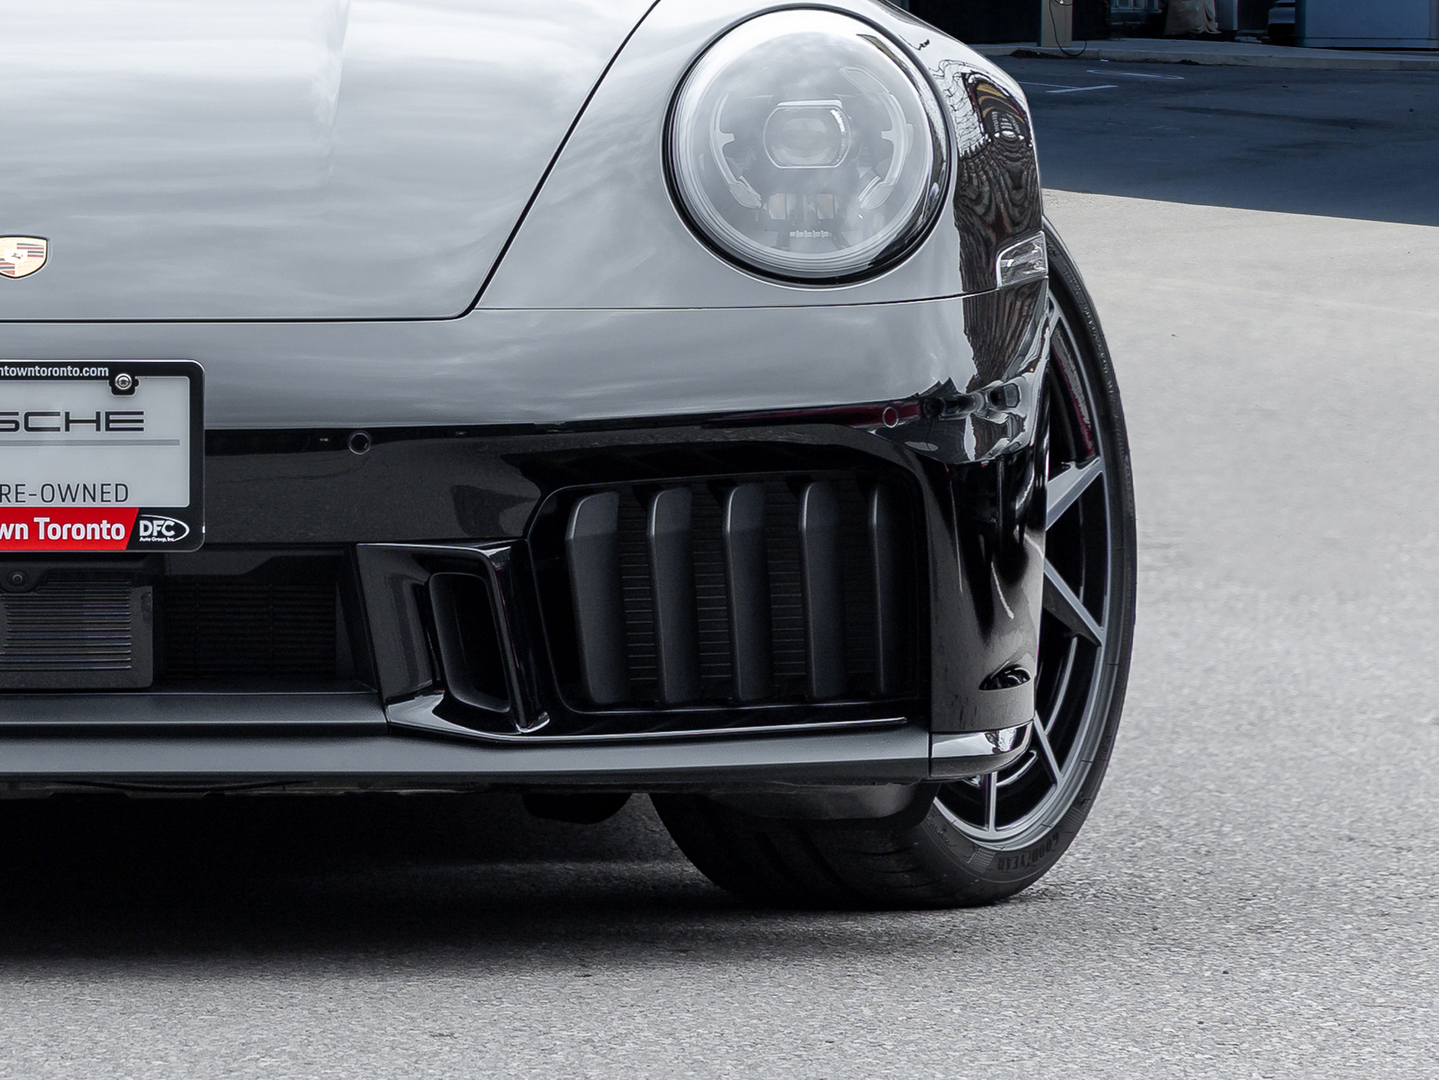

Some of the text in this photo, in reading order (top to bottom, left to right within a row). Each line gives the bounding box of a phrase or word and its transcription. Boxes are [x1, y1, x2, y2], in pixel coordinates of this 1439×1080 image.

[33, 516, 126, 541] Toronto
[139, 520, 175, 536] DFC
[997, 832, 1060, 871] GOODYEAR
